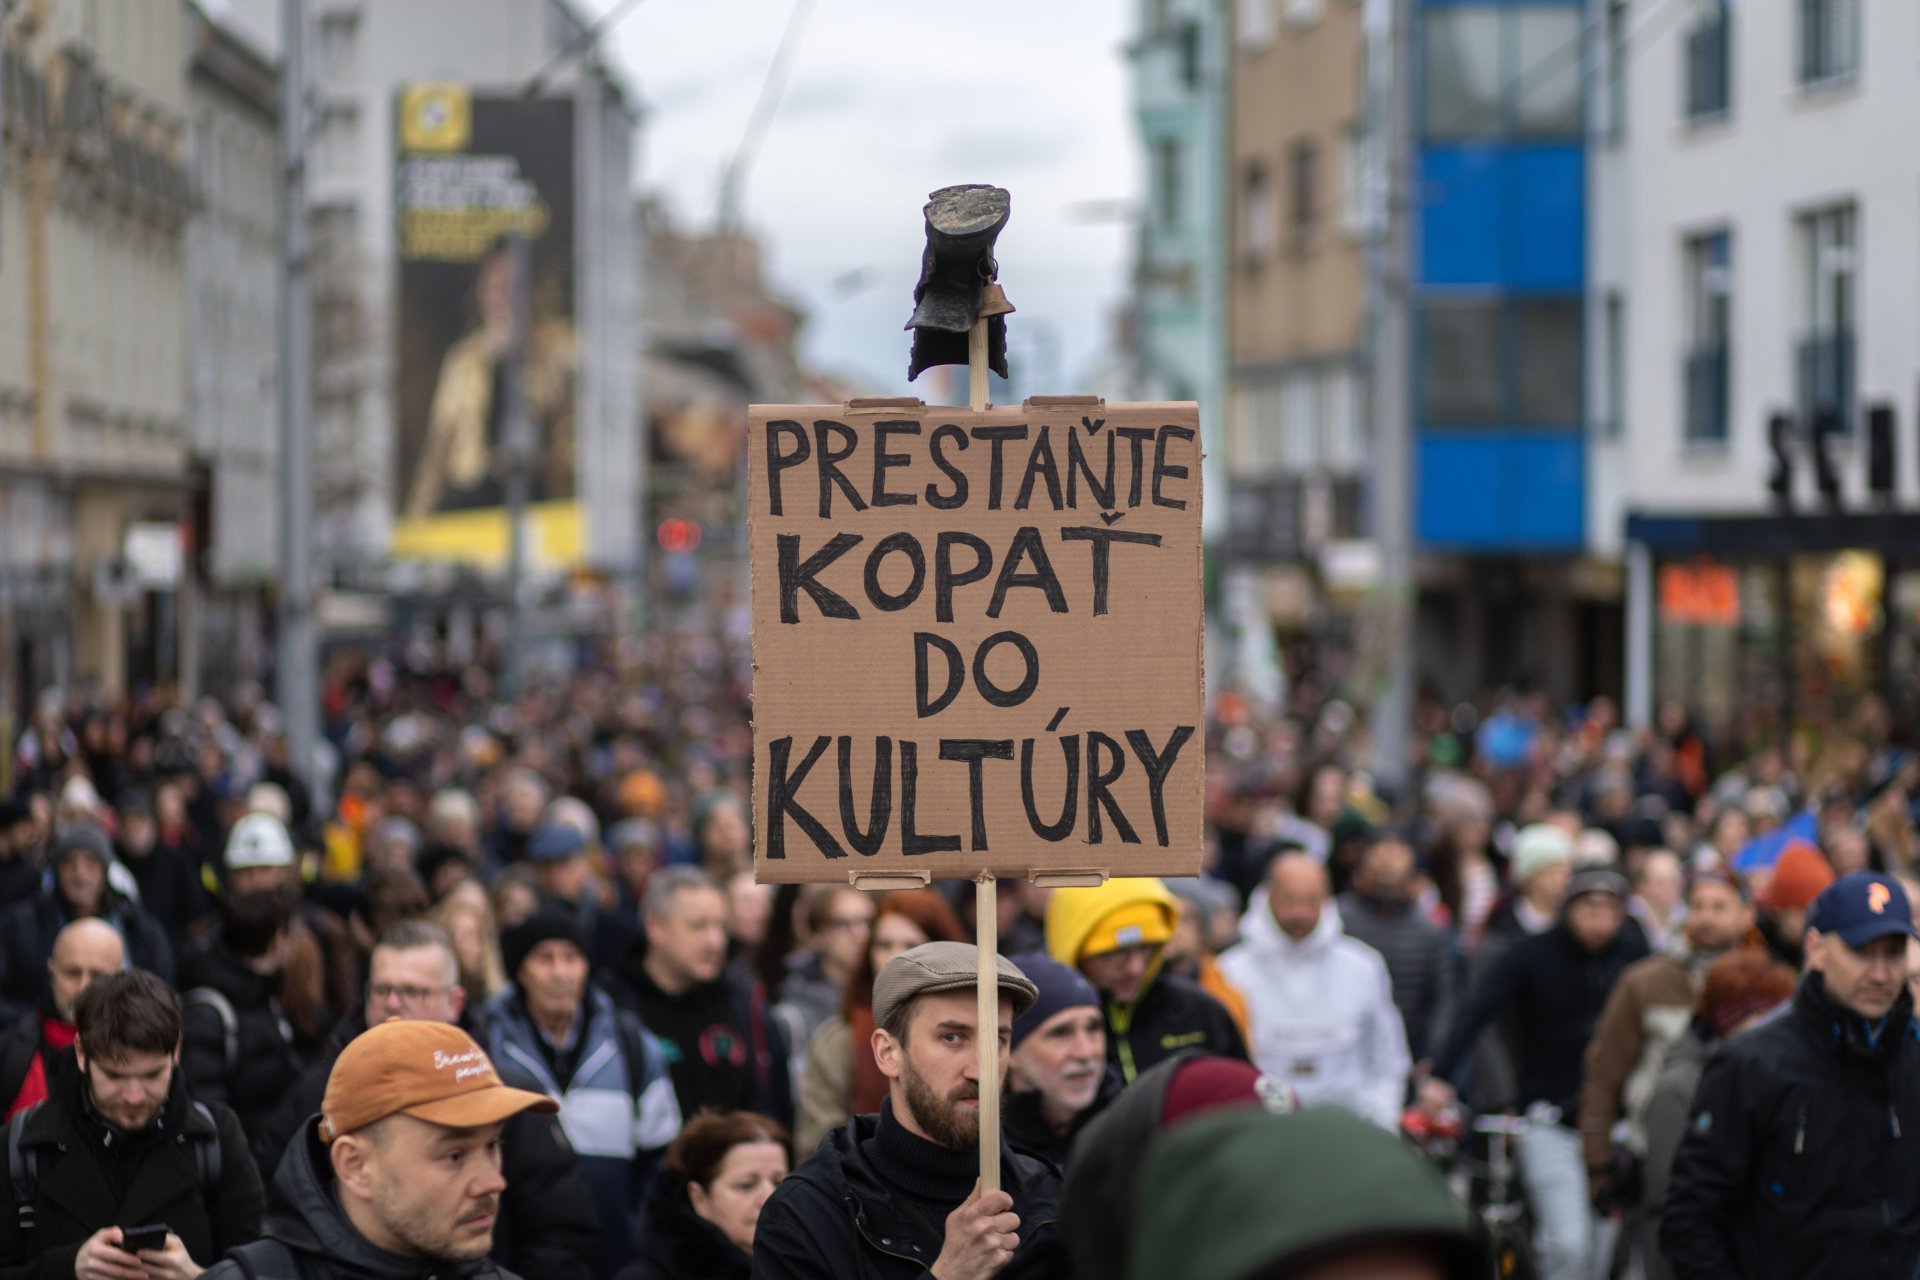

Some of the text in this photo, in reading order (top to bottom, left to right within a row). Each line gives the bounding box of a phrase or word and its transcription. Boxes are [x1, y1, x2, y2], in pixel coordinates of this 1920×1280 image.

[766, 416, 1196, 519] PRESTAŇTE
[776, 512, 1163, 624] KOPAŤ
[913, 630, 1040, 719] DO
[766, 706, 1196, 860] KULTÚRY
